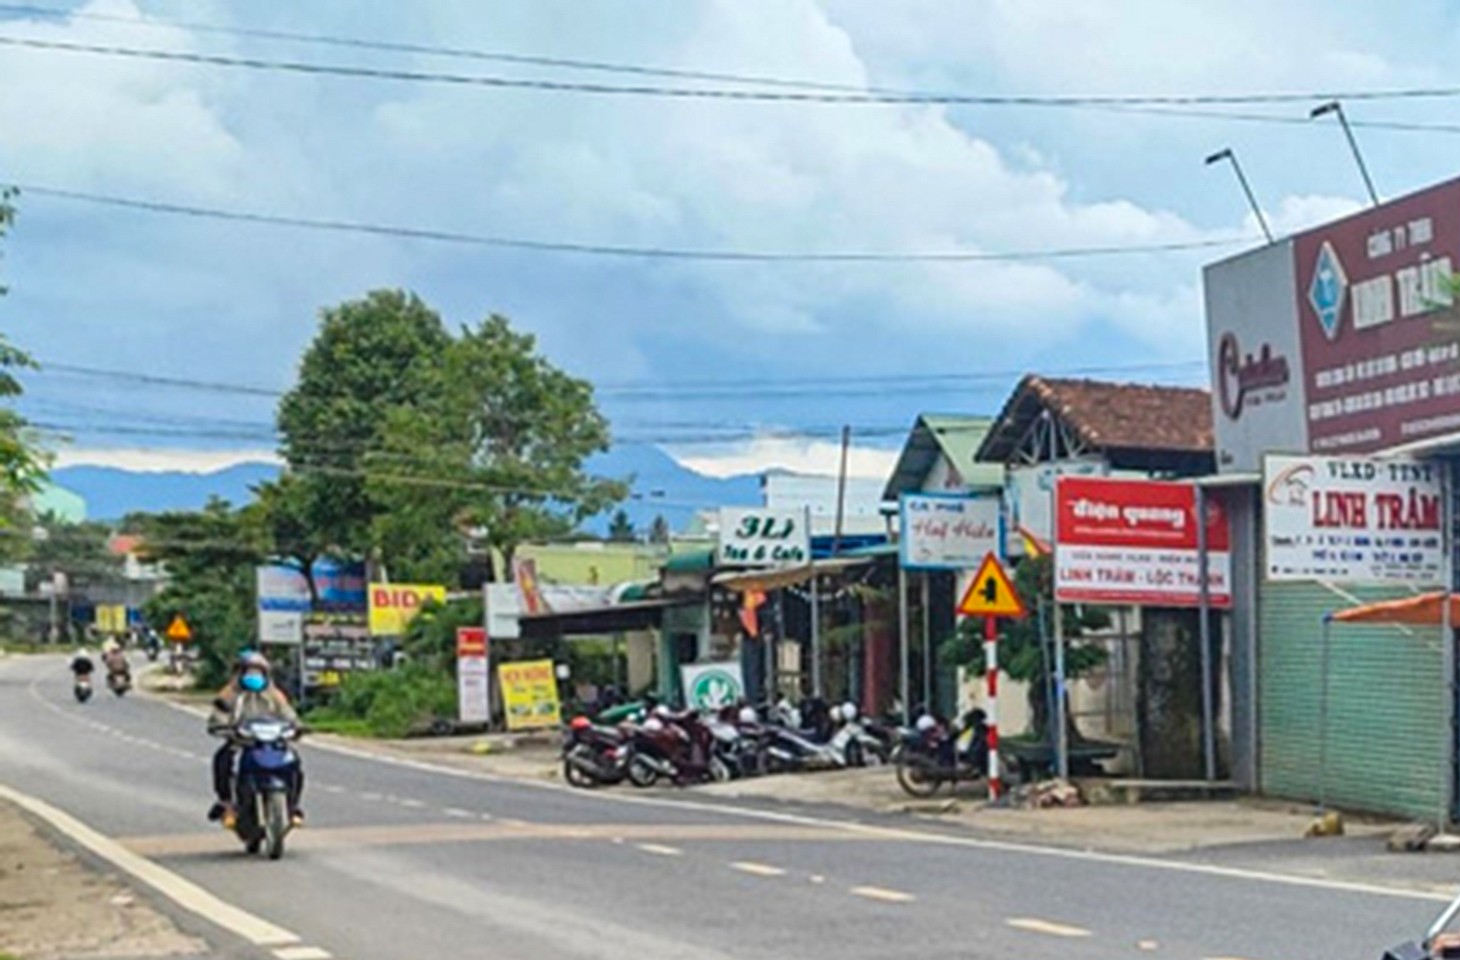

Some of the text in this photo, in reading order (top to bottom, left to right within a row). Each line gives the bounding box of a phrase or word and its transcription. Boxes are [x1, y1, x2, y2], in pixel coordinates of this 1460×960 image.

[1123, 506, 1186, 529] quang
[1312, 486, 1440, 531] LINH TRÂM
